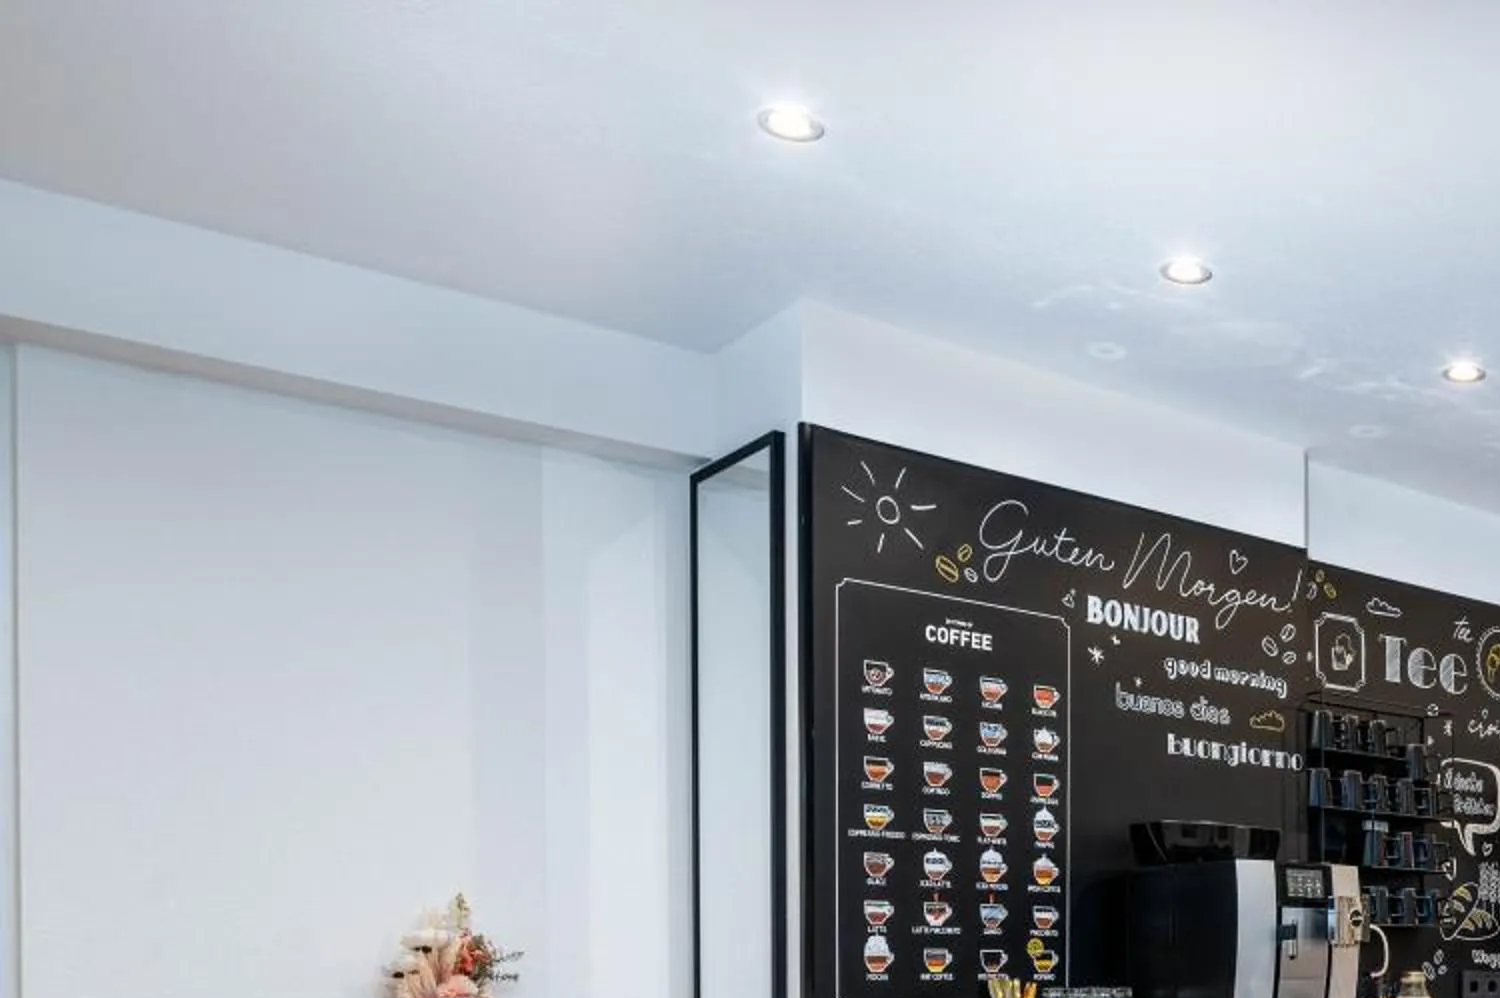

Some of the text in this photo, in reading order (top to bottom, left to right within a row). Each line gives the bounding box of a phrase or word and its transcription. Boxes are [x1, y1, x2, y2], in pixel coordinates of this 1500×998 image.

[979, 500, 1303, 629] Guten Morgen!
[925, 624, 993, 651] COFFEE
[1087, 595, 1200, 644] BONJOUR
[1163, 656, 1288, 699] good morning
[1378, 633, 1469, 695] Tee
[1115, 681, 1185, 718] buenos
[1167, 732, 1304, 771] buongiorno
